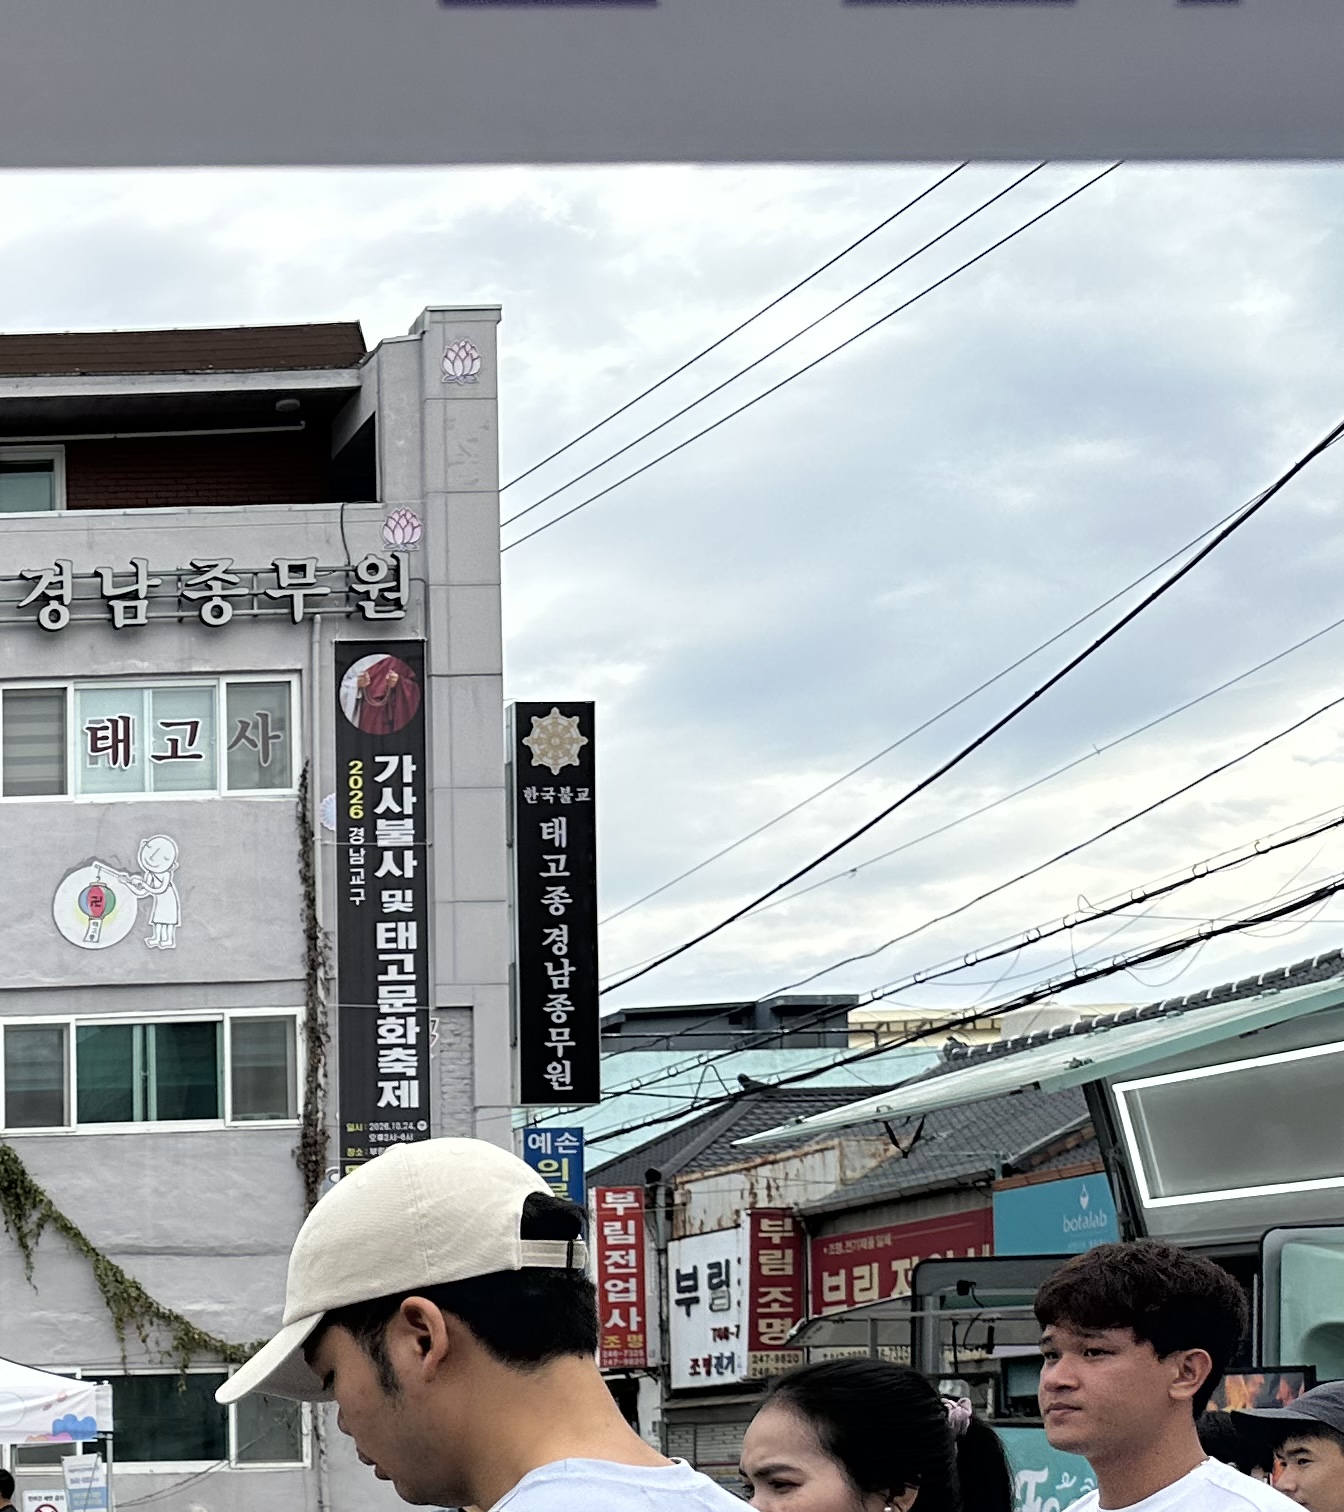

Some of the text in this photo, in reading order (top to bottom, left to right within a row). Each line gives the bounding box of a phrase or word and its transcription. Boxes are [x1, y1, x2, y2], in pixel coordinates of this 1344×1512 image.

[17, 551, 414, 632] 경남종무원
[84, 711, 284, 768] 태고사
[523, 785, 591, 804] 한국불교
[348, 761, 366, 905] 2026 경남교구
[374, 755, 420, 1108] 가사불사 및 태고문화축제
[527, 1131, 580, 1154] 예손
[1062, 1209, 1108, 1233] botalab
[601, 1191, 643, 1332] 부림전업사
[756, 1217, 794, 1345] 부림조명
[603, 1335, 643, 1349] 조명
